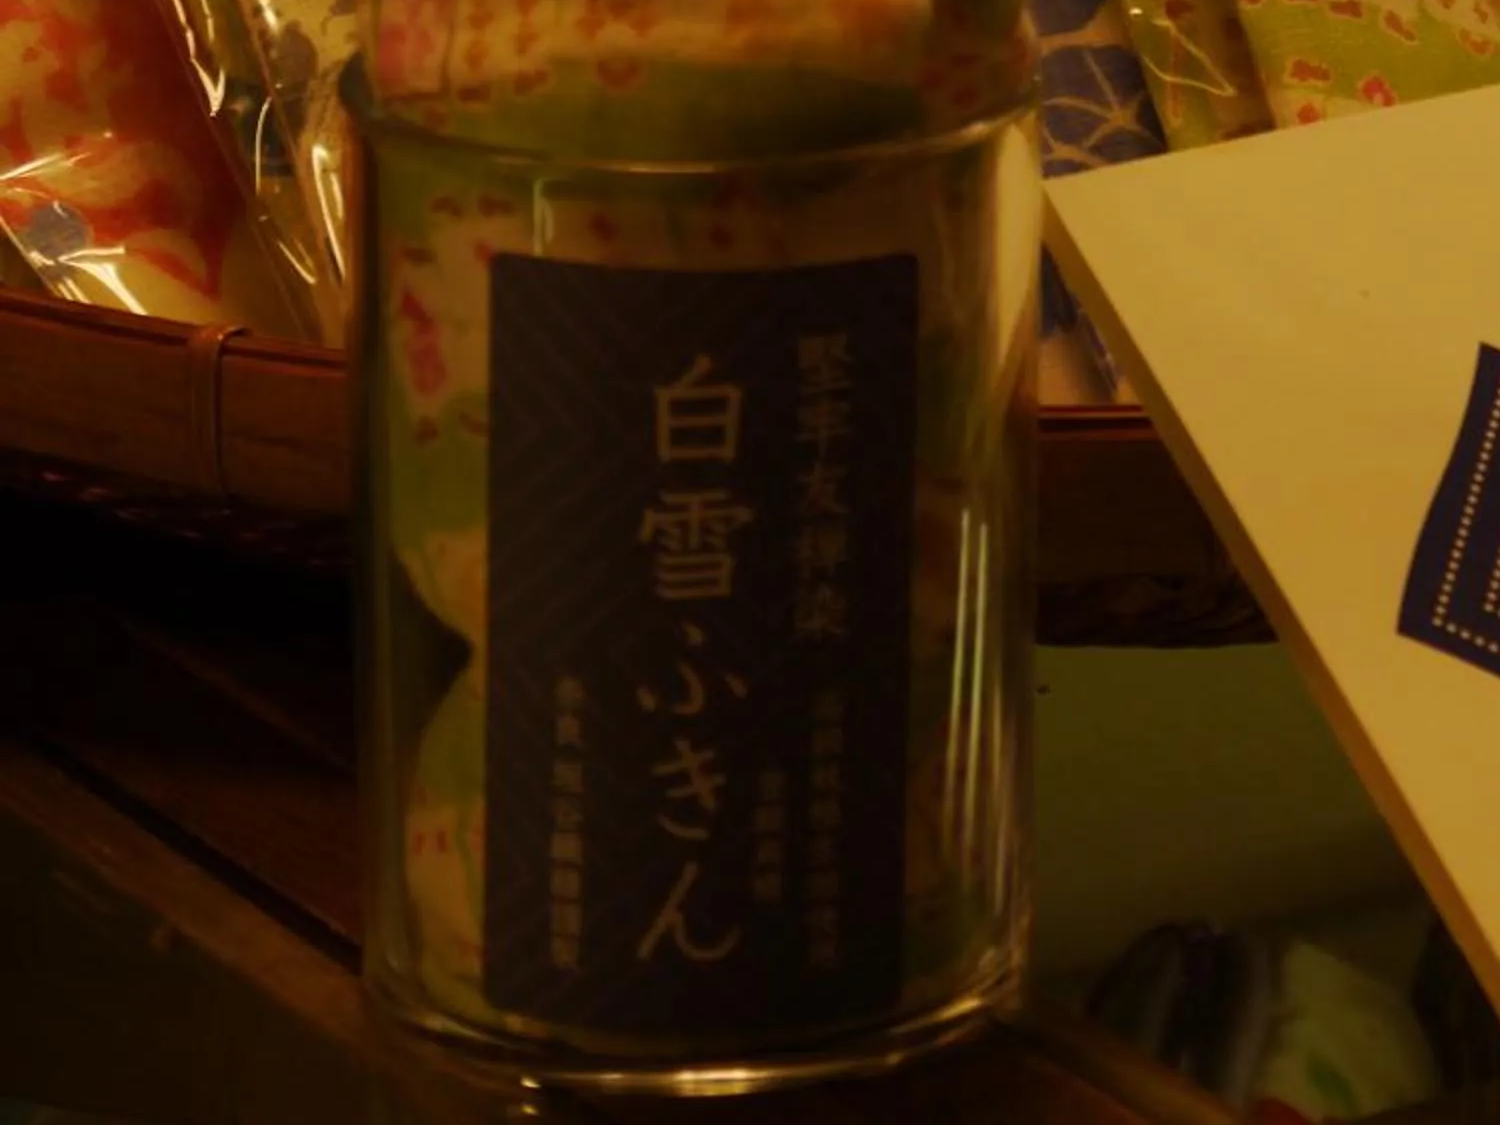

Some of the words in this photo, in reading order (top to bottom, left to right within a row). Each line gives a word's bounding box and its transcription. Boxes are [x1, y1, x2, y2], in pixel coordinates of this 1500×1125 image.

[635, 352, 754, 962] 白雪ふきん
